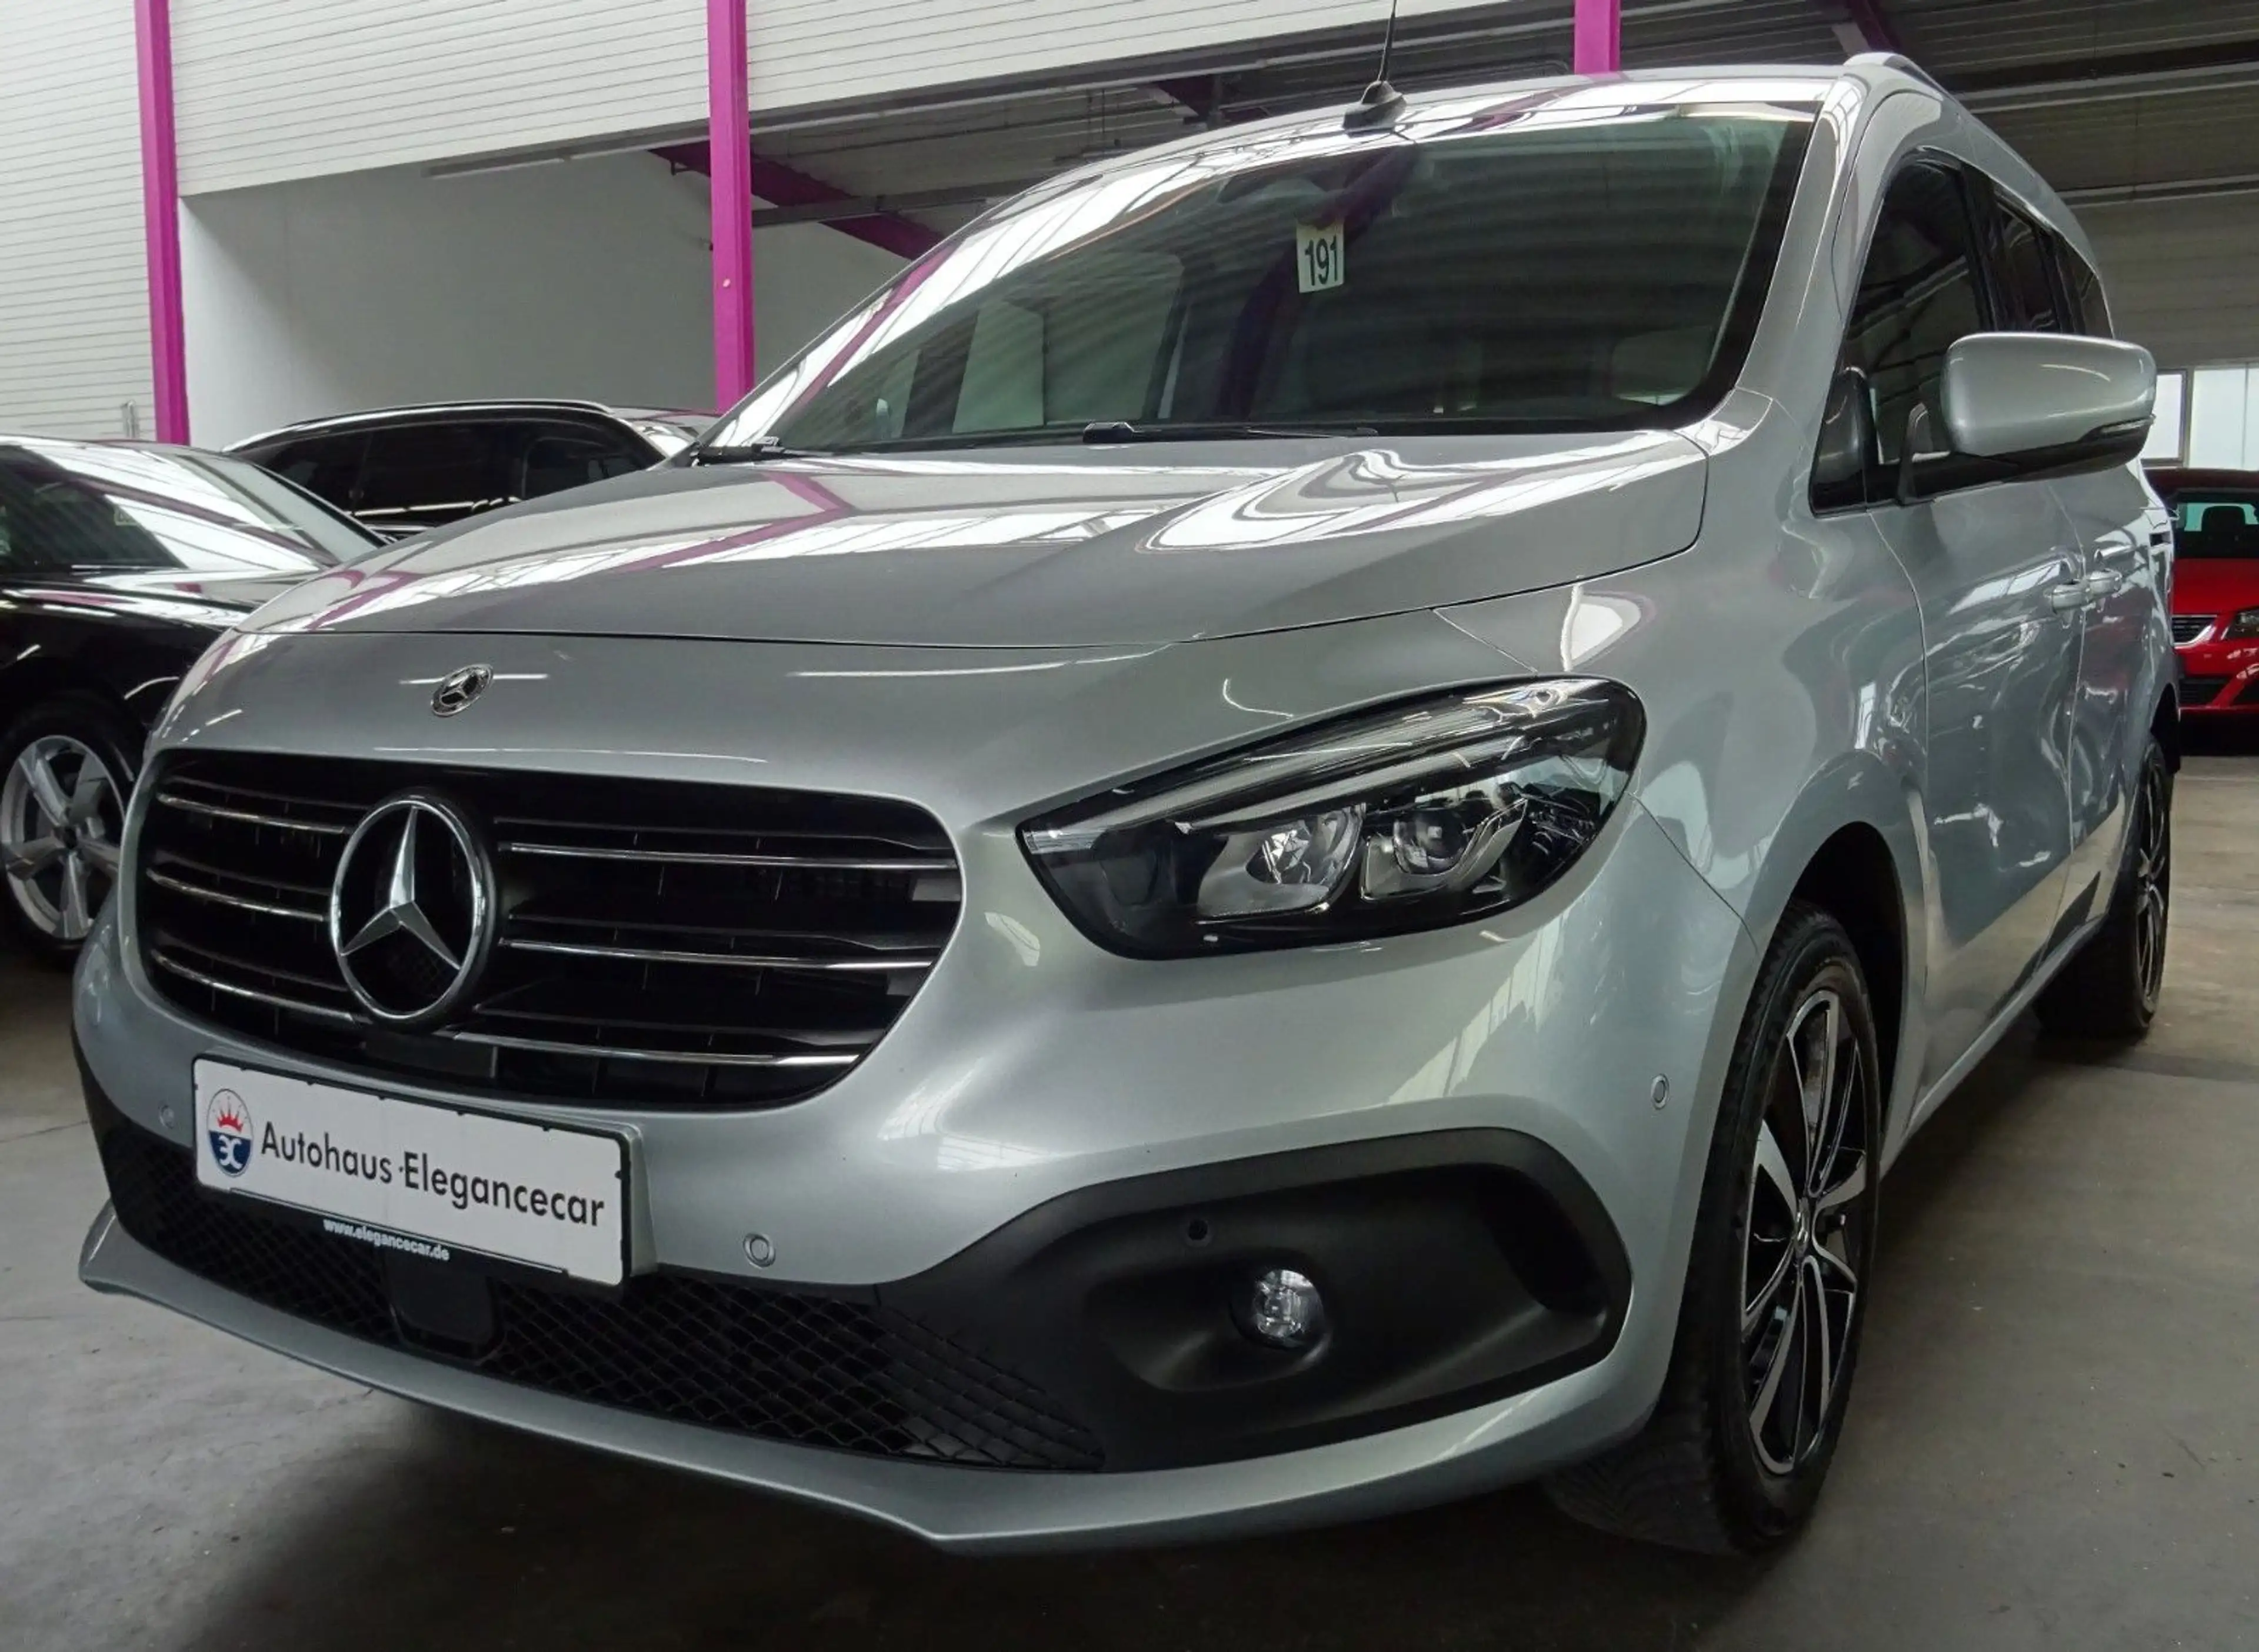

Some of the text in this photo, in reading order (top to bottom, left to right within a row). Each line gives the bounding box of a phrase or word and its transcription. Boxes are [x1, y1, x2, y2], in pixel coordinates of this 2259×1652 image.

[1305, 235, 1337, 286] 191
[261, 1121, 604, 1226] Autohaus Elegancecar
[324, 1219, 450, 1260] www.elegancecar.de
